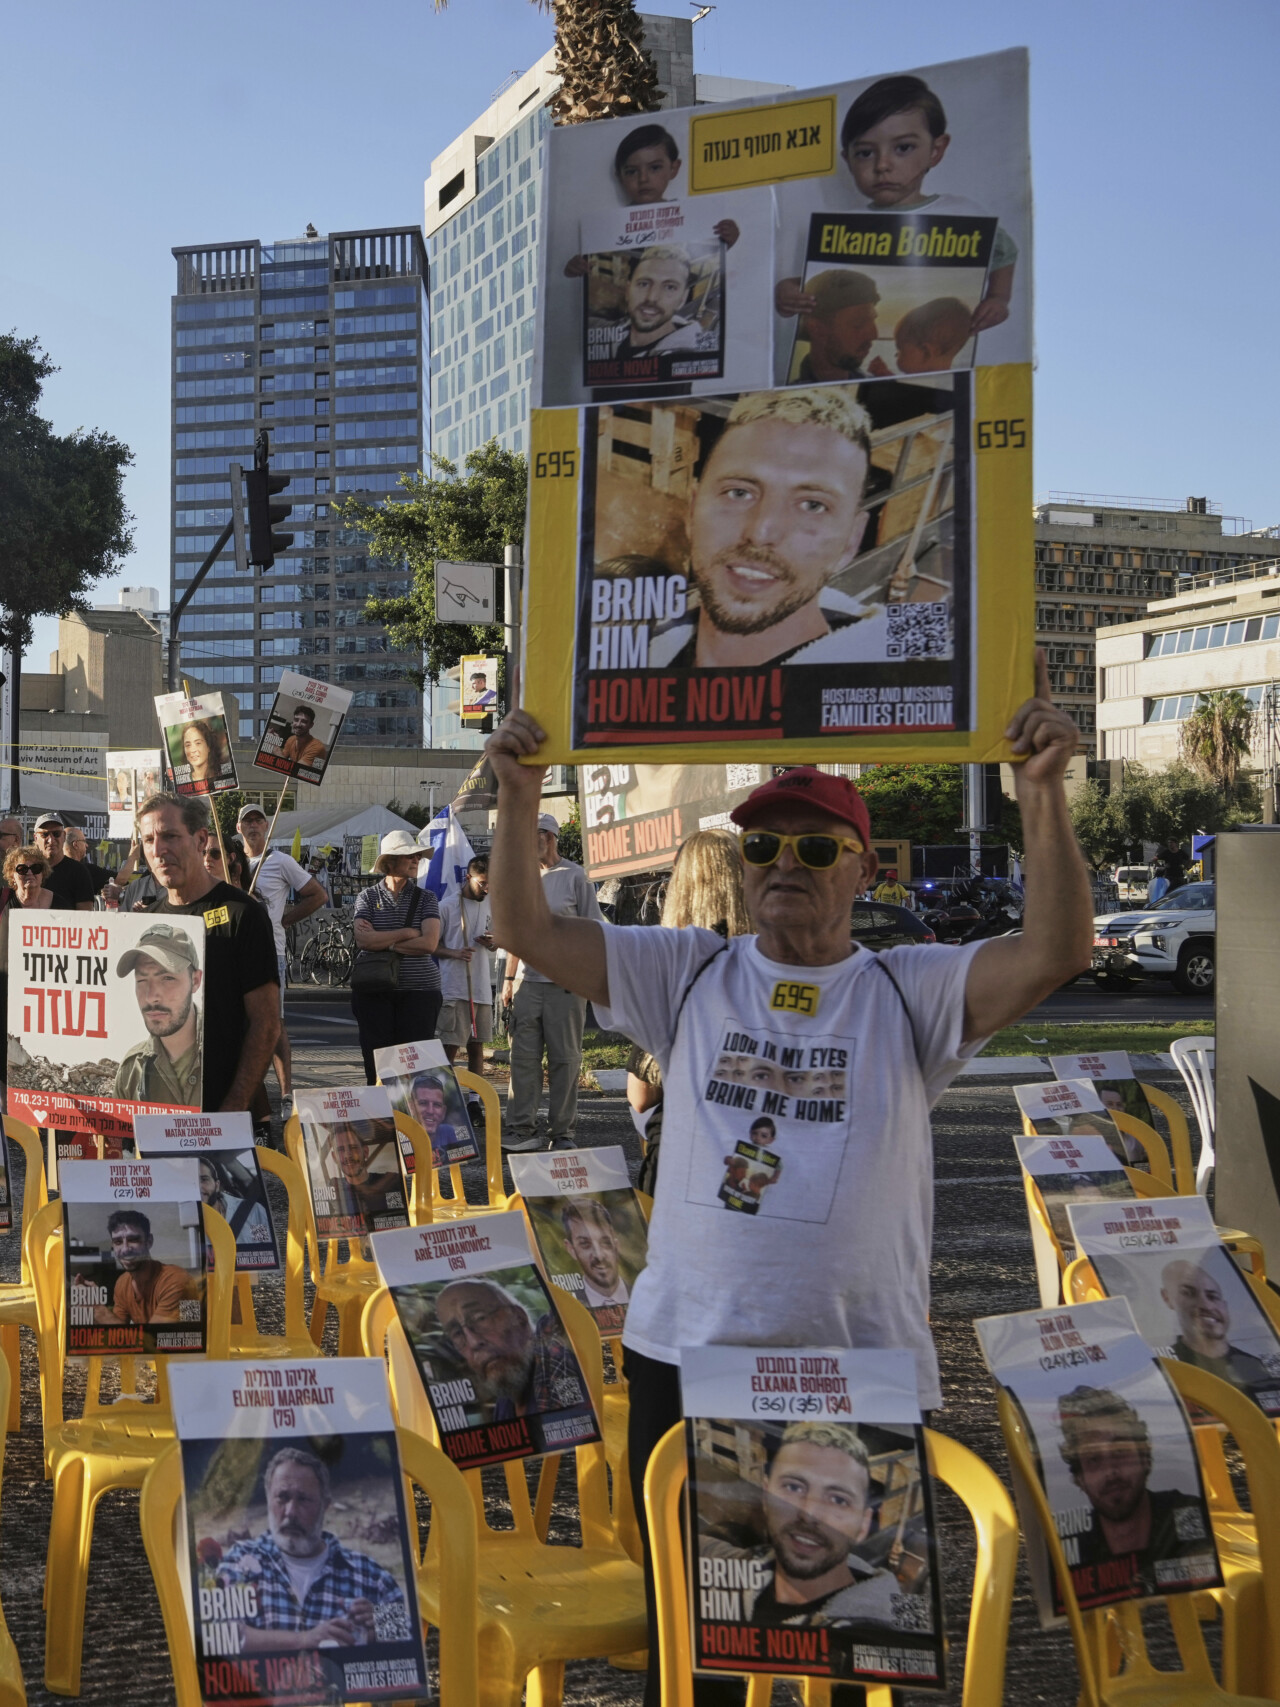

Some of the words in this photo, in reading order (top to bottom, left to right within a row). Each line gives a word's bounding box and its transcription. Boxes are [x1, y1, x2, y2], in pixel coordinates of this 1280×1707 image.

[743, 132, 781, 157] חטוף
[785, 125, 820, 149] אבא
[703, 138, 741, 163] בעזה
[818, 223, 892, 257] Elkana
[896, 228, 981, 259] Bohbot
[976, 418, 1025, 450] 695
[534, 450, 575, 479] 695
[590, 574, 687, 624] BRING
[587, 624, 649, 672] HIM
[586, 675, 677, 724] HOME
[686, 668, 782, 722] NOW!
[821, 688, 876, 704] HOSTAGES
[878, 687, 900, 703] AND
[901, 685, 952, 702] MISSING
[820, 703, 891, 727] FAMILIES
[894, 702, 953, 725] FORUM
[35, 755, 71, 764] Museum
[73, 755, 82, 764] of
[84, 756, 98, 764] Art
[587, 825, 632, 865] HOME
[633, 807, 682, 855] NOW!
[206, 908, 228, 926] 569
[21, 924, 83, 950] שוכחים
[87, 925, 108, 950] לא
[22, 952, 69, 983] איתי
[75, 955, 108, 986] את
[772, 982, 815, 1013] 695
[23, 987, 108, 1038] בעזה
[722, 1031, 759, 1055] LOOK
[762, 1040, 777, 1061] IN
[781, 1046, 804, 1068] MY
[809, 1048, 847, 1068] EYES
[51, 1097, 76, 1110] ונחטף
[77, 1099, 97, 1114] בקרב
[99, 1100, 114, 1113] נפל
[705, 1080, 757, 1111] BRING
[761, 1090, 789, 1117] ME
[794, 1100, 846, 1123] HOME
[48, 1113, 68, 1125] שלנו
[69, 1115, 97, 1128] האריות
[101, 1120, 114, 1132] מלך
[164, 1128, 187, 1138] MATAN
[187, 1127, 223, 1138] ZANGAUKER
[109, 1176, 130, 1188] ARIEL
[130, 1176, 153, 1187] CUNIO
[414, 1246, 434, 1262] ARIE
[433, 1237, 492, 1259] ZALMANOWICZ
[447, 1256, 467, 1272] (85)
[244, 1368, 283, 1388] מרגלית
[283, 1367, 319, 1387] אליהו
[754, 1356, 796, 1375] בוחבוט
[798, 1357, 840, 1376] אלקנה
[750, 1375, 797, 1393] ELKANA
[799, 1377, 848, 1394] BOHBOT
[232, 1388, 276, 1409] ELIYAHU
[277, 1386, 336, 1408] MARGALIT
[272, 1408, 297, 1430] (75)
[698, 1556, 762, 1591] BRING
[199, 1585, 258, 1622] BRING
[699, 1588, 741, 1621] HIM
[201, 1621, 242, 1657] HIM
[700, 1624, 760, 1657] HOME
[766, 1627, 829, 1663] NOW!
